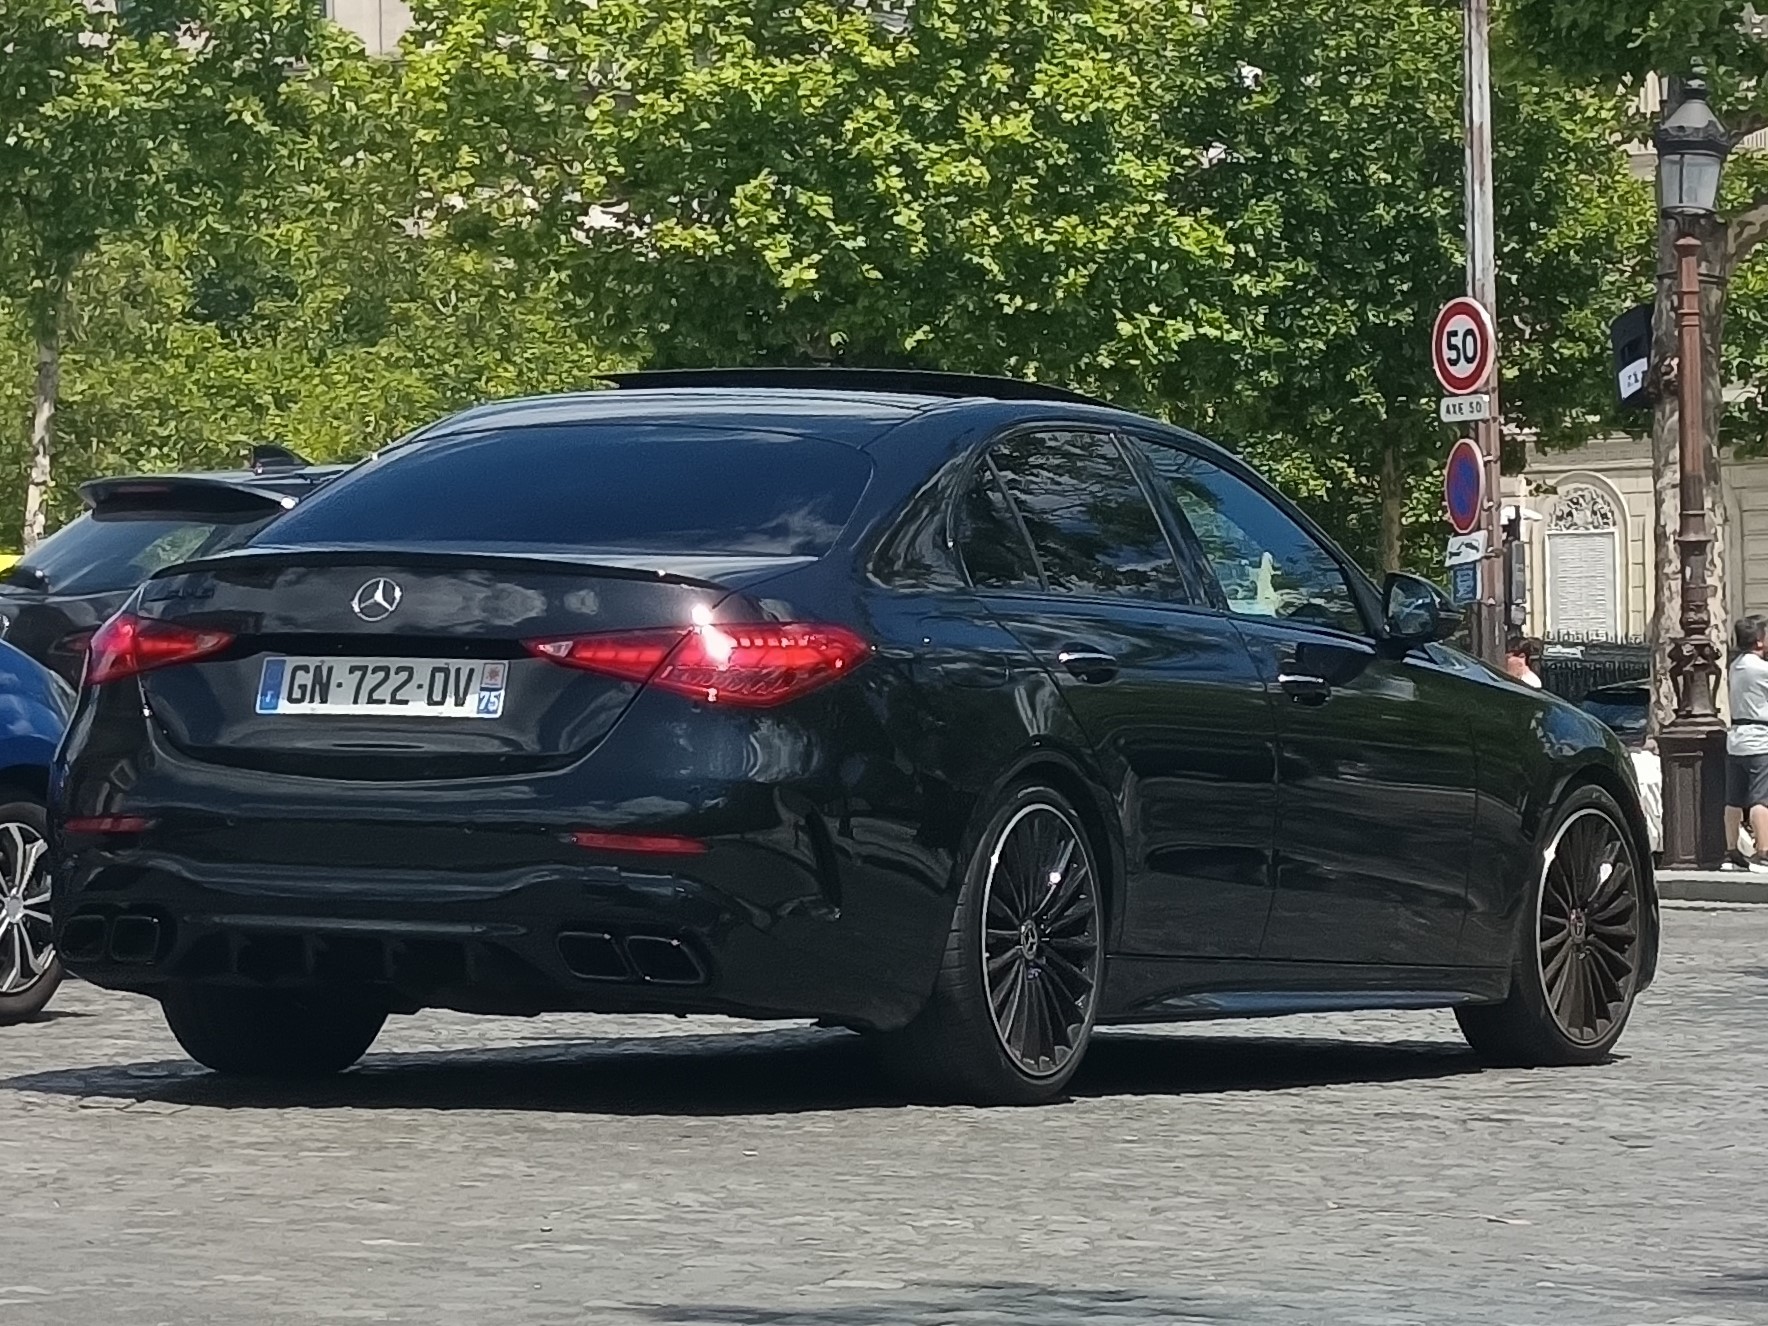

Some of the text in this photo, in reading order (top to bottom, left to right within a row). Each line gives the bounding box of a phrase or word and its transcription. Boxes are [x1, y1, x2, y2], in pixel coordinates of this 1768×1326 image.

[1446, 328, 1478, 366] 50
[1445, 401, 1482, 416] AXE 50
[478, 691, 500, 712] 75
